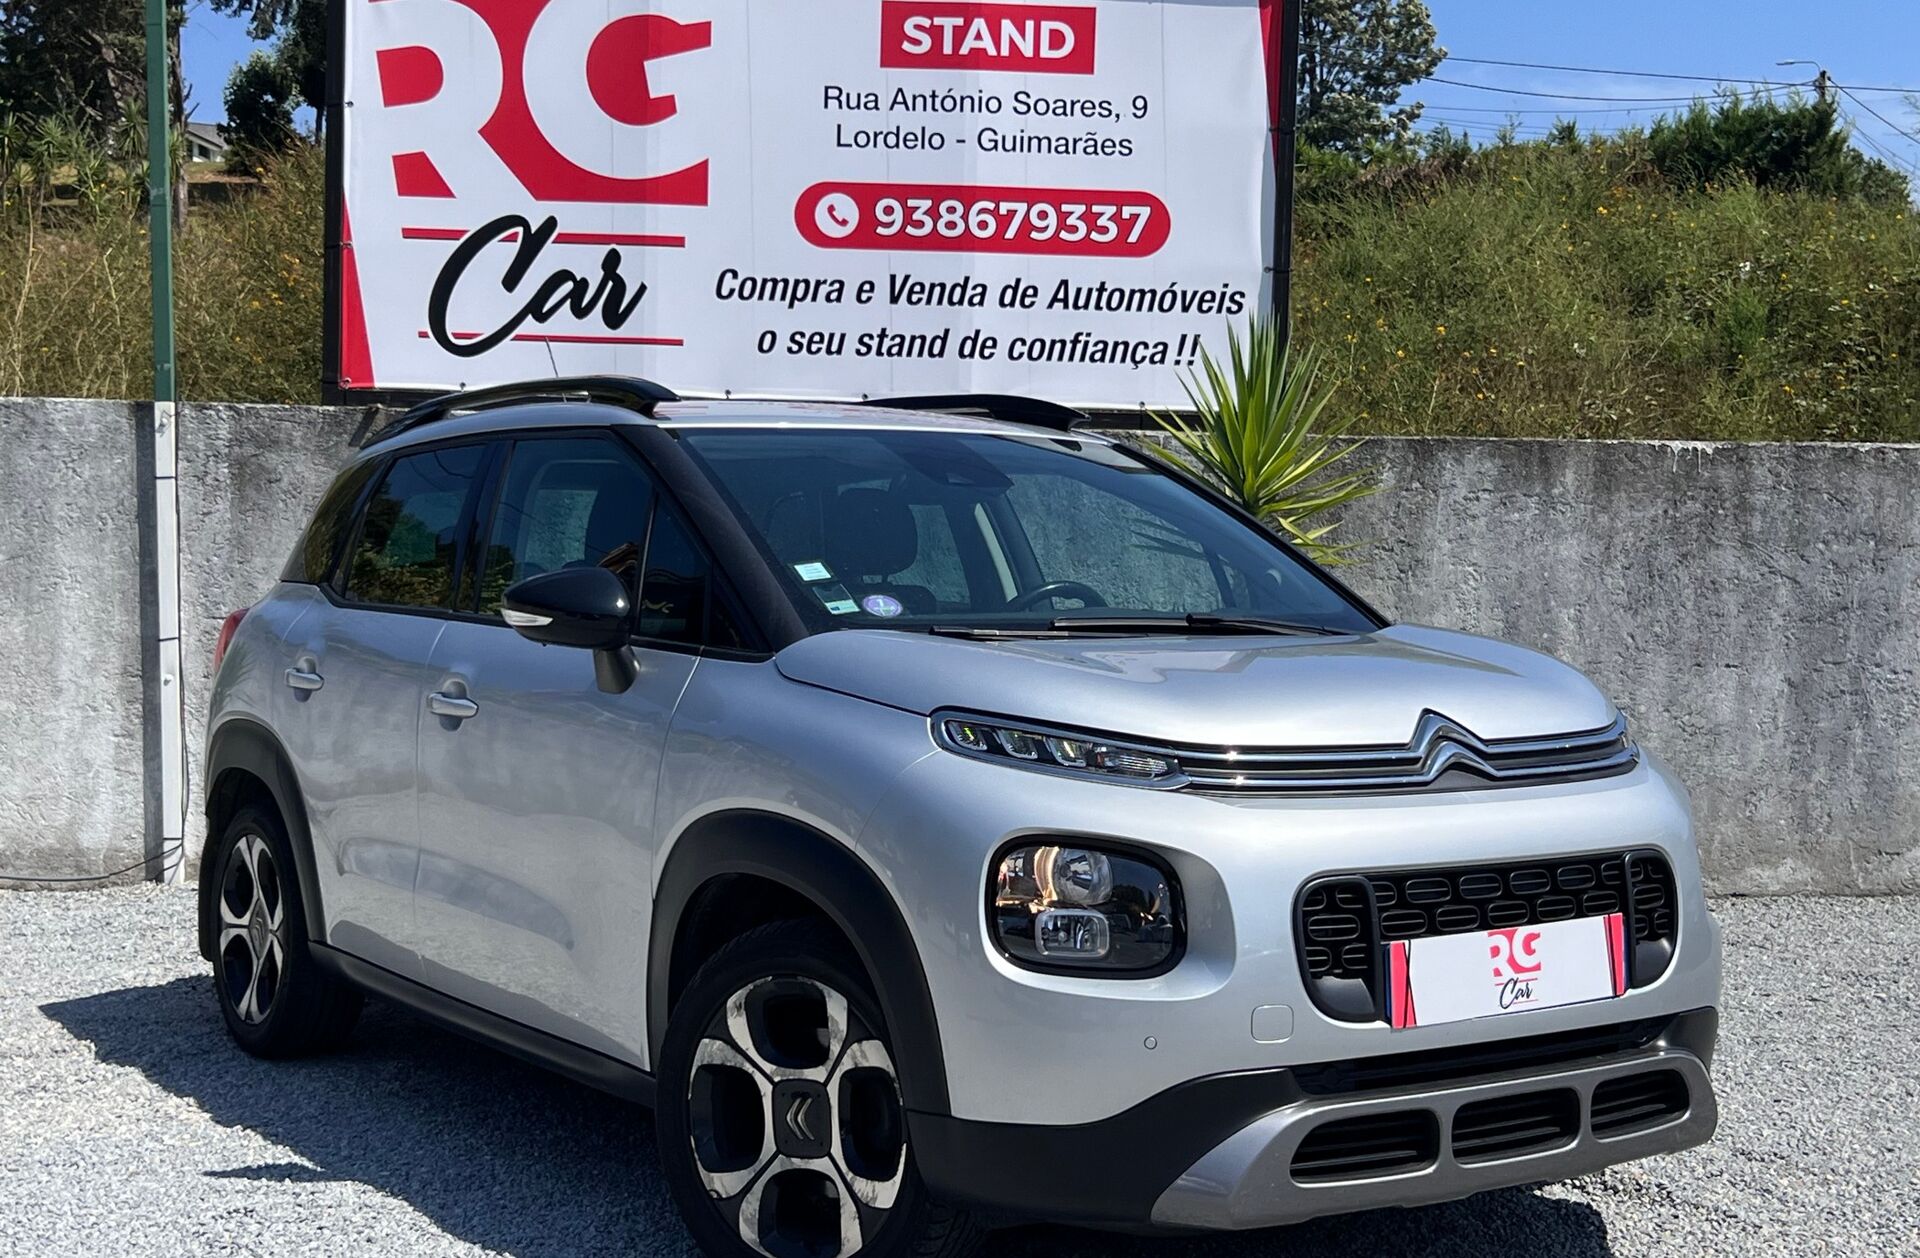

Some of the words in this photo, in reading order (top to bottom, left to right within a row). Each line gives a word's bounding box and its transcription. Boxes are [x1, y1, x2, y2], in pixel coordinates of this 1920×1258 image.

[900, 16, 1076, 59] STAND
[823, 85, 881, 112] Rua
[888, 87, 1002, 114] António
[1012, 90, 1122, 123] Soares,
[1131, 95, 1148, 120] 9
[835, 123, 946, 151] Lordelo
[977, 127, 1134, 157] Guimarães
[873, 197, 1152, 243] 938679337
[428, 214, 648, 358] Car
[715, 268, 846, 310] Compra
[855, 278, 876, 305] e
[889, 273, 986, 308] Venda
[998, 277, 1039, 310] de
[1046, 278, 1246, 315] Automóveis
[757, 329, 778, 355] o
[786, 330, 847, 357] seu
[854, 327, 950, 359] stand
[957, 328, 998, 361] de
[1488, 929, 1542, 978] RG
[1499, 977, 1534, 1010] Car
